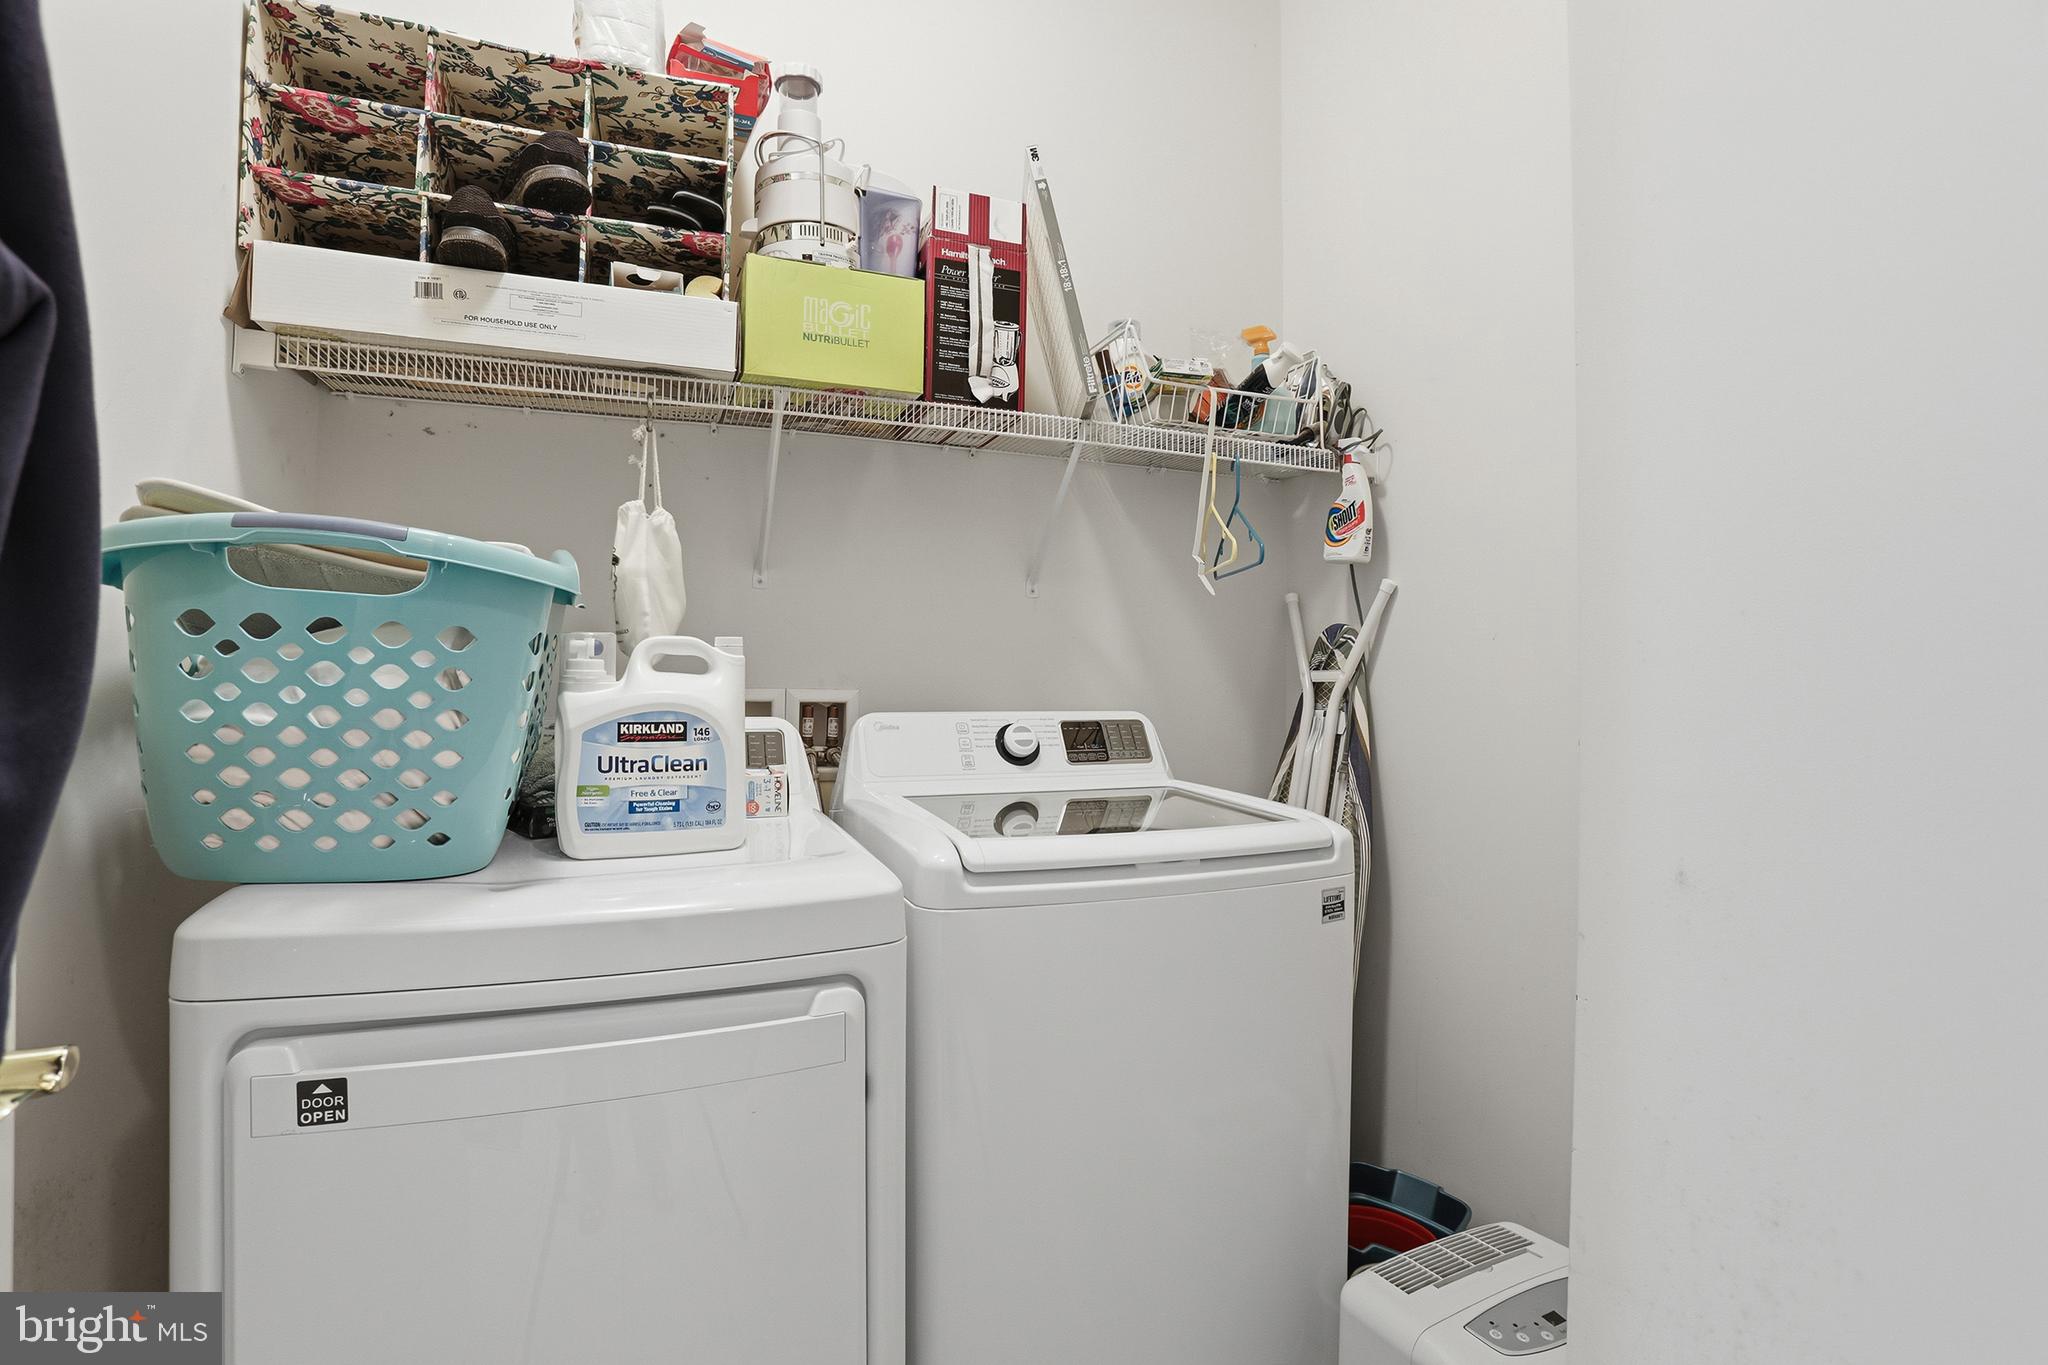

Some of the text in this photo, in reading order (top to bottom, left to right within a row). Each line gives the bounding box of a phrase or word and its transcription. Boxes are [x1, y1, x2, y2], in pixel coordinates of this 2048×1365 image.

[1029, 147, 1040, 162] 3M
[480, 317, 522, 327] HOUSEHOLD
[524, 321, 538, 329] USE
[539, 323, 558, 331] ONLY
[1332, 501, 1357, 530] SHOUT
[620, 723, 685, 735] KIRKLAND
[693, 727, 710, 736] 146
[597, 755, 708, 774] UltraClean
[650, 789, 656, 797] &
[657, 788, 678, 797] Clear
[301, 1096, 344, 1109] DOOR
[300, 1109, 345, 1124] OPEN
